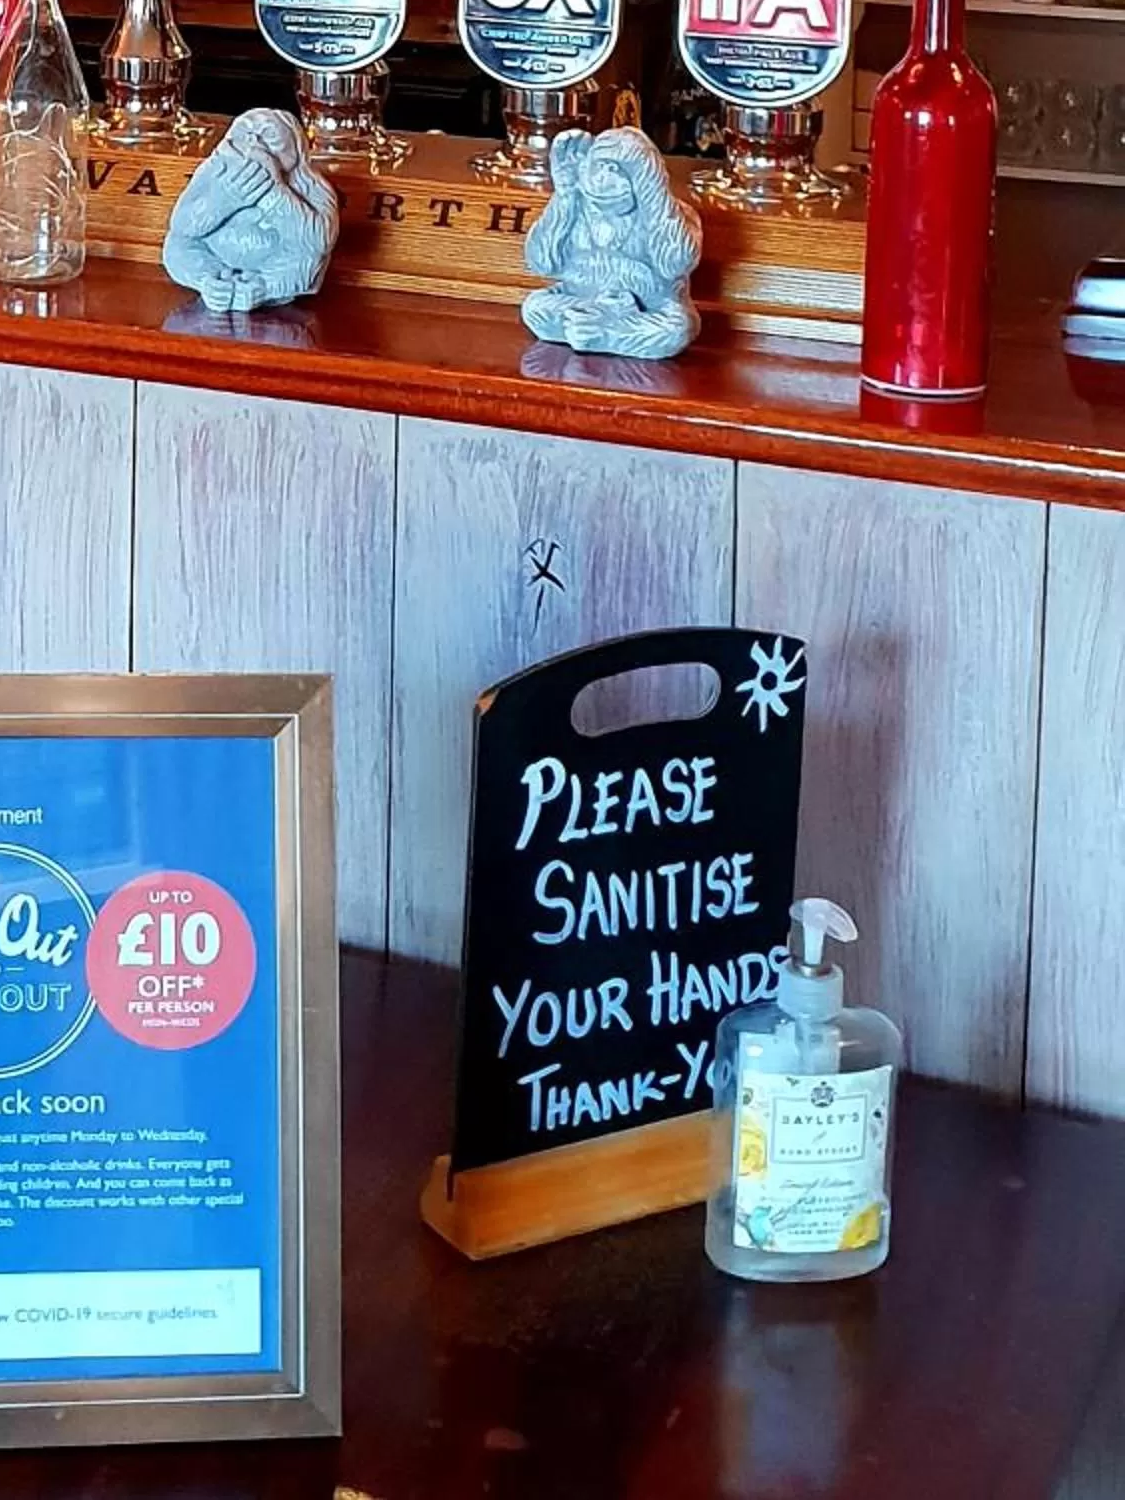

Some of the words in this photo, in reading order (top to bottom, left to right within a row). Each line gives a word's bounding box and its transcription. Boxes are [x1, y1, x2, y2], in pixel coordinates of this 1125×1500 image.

[515, 756, 717, 850] PLEASE
[149, 891, 170, 905] UP
[171, 891, 194, 905] TO
[532, 853, 761, 945] SANITISE
[117, 911, 222, 968] £10
[128, 1001, 156, 1015] PER
[158, 1000, 215, 1015] PERSON
[492, 977, 634, 1059] YOUR
[517, 1041, 733, 1132] THANK-YO
[40, 1094, 106, 1116] soon
[20, 1132, 68, 1146] anytime
[70, 1129, 118, 1146] Monday
[120, 1131, 135, 1142] to
[148, 1157, 203, 1173] Everyone
[76, 1177, 101, 1189] And
[104, 1179, 126, 1192] you
[129, 1178, 150, 1188] can
[153, 1178, 186, 1188] come
[189, 1175, 216, 1188] back
[17, 1195, 41, 1209] The
[44, 1195, 95, 1208] discount
[98, 1195, 136, 1208] works
[138, 1194, 165, 1206] with
[204, 1192, 244, 1208] special
[13, 1306, 93, 1324] COVID-19
[96, 1309, 143, 1322] secure
